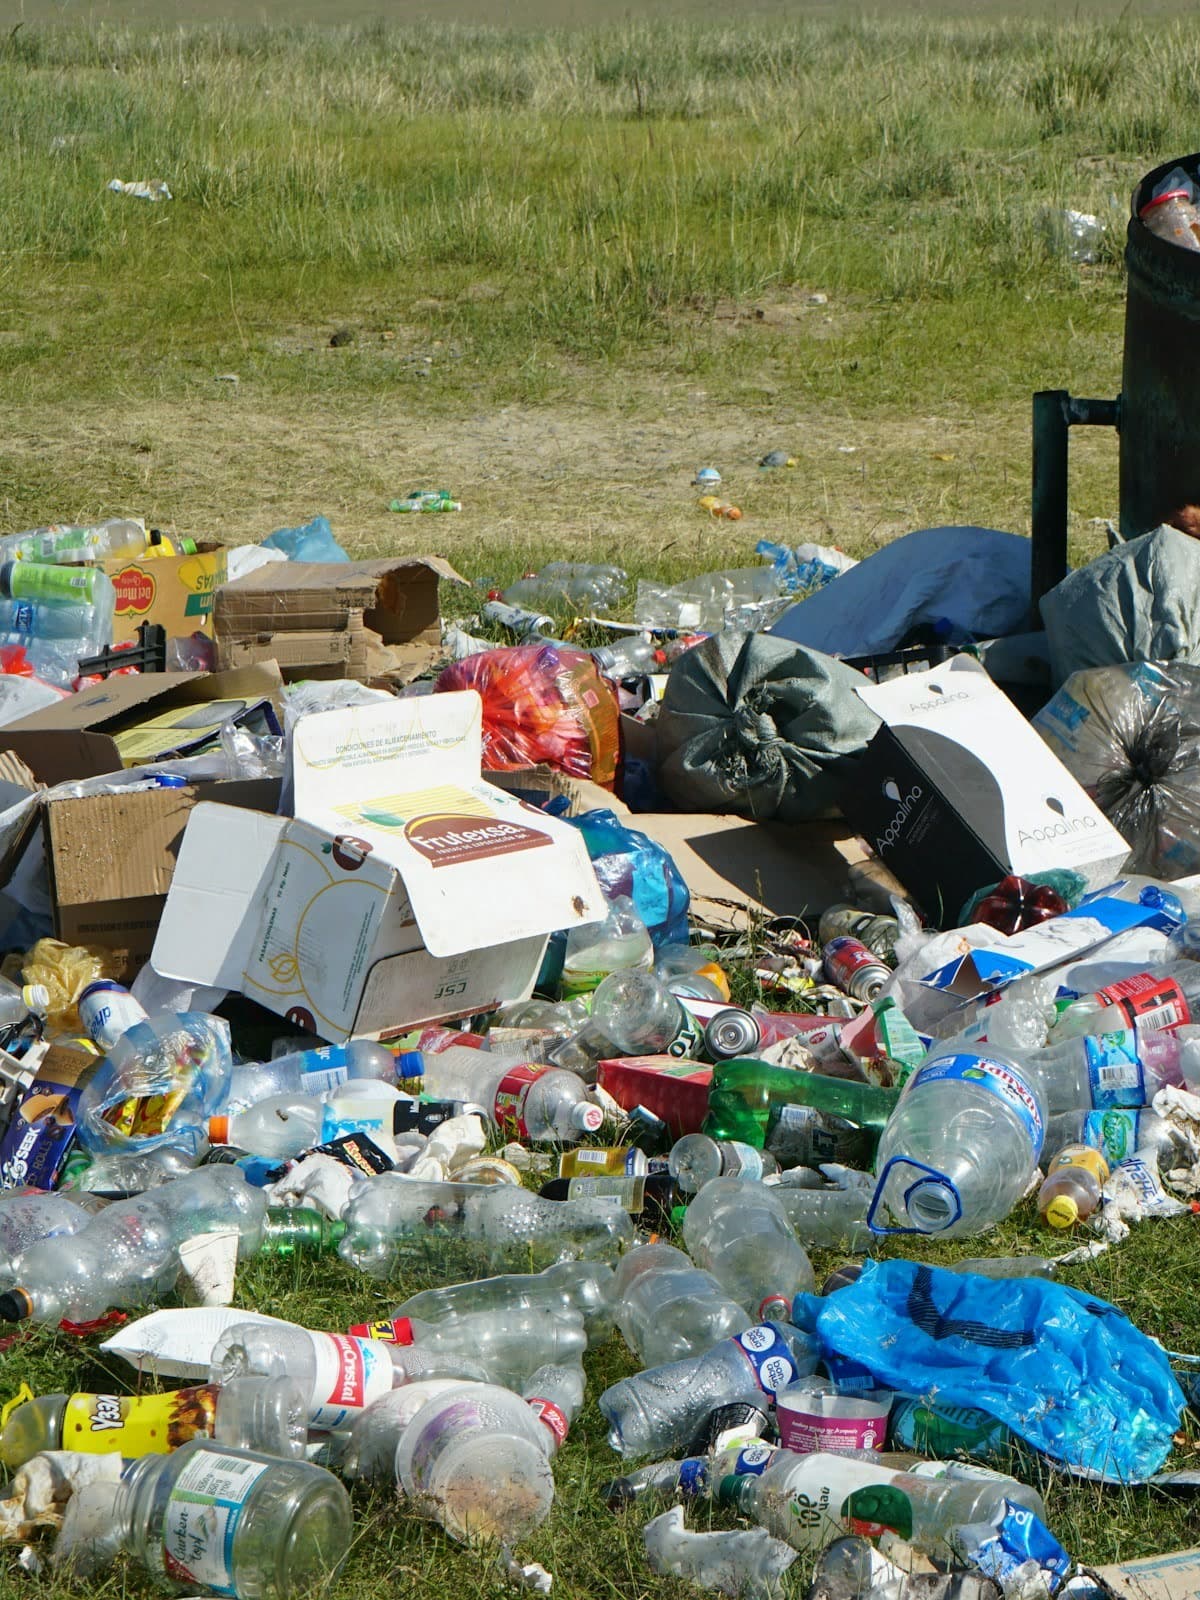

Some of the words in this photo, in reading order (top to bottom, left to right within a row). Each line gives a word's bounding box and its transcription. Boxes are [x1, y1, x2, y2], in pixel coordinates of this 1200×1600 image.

[116, 585, 138, 600] Mon
[876, 785, 923, 856] Appalina
[1017, 814, 1097, 847] Appalina
[409, 823, 520, 852] Frutexsa
[434, 982, 467, 1000] CSF
[16, 1127, 41, 1160] SEEK
[336, 1334, 357, 1402] uaCrystal
